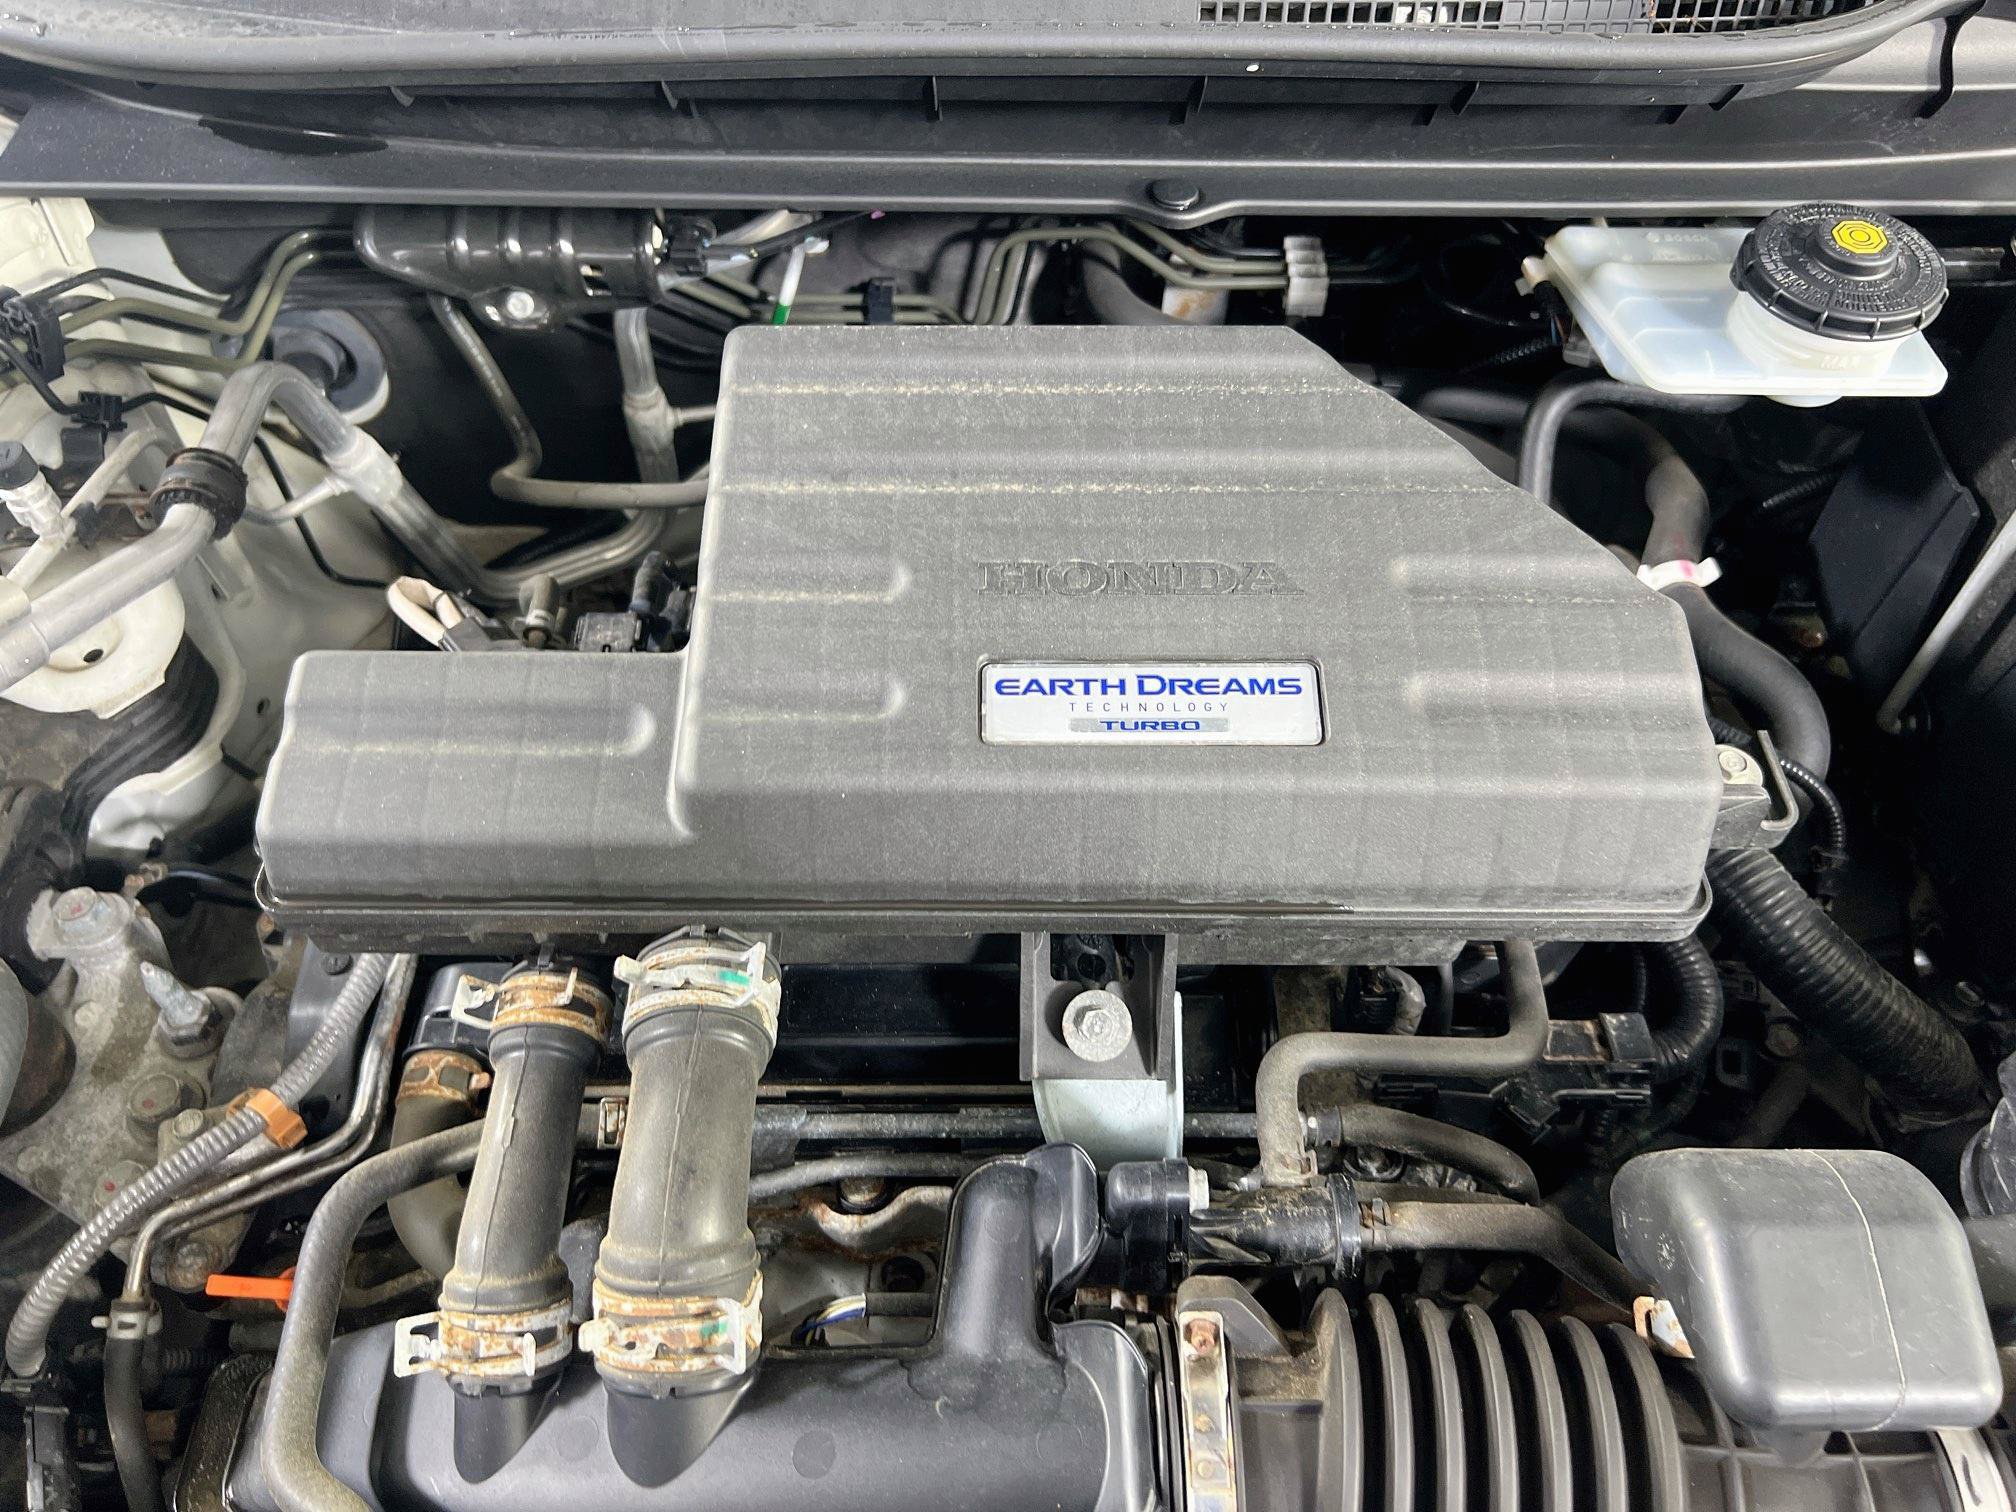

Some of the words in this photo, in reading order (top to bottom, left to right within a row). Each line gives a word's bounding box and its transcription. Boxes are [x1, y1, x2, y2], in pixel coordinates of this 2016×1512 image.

[977, 561, 1304, 596] HONDA
[995, 678, 1126, 696] EARTH
[1136, 674, 1303, 696] DREAMS
[1070, 702, 1229, 712] TECHNOLOGY
[1099, 720, 1201, 731] TURBO
